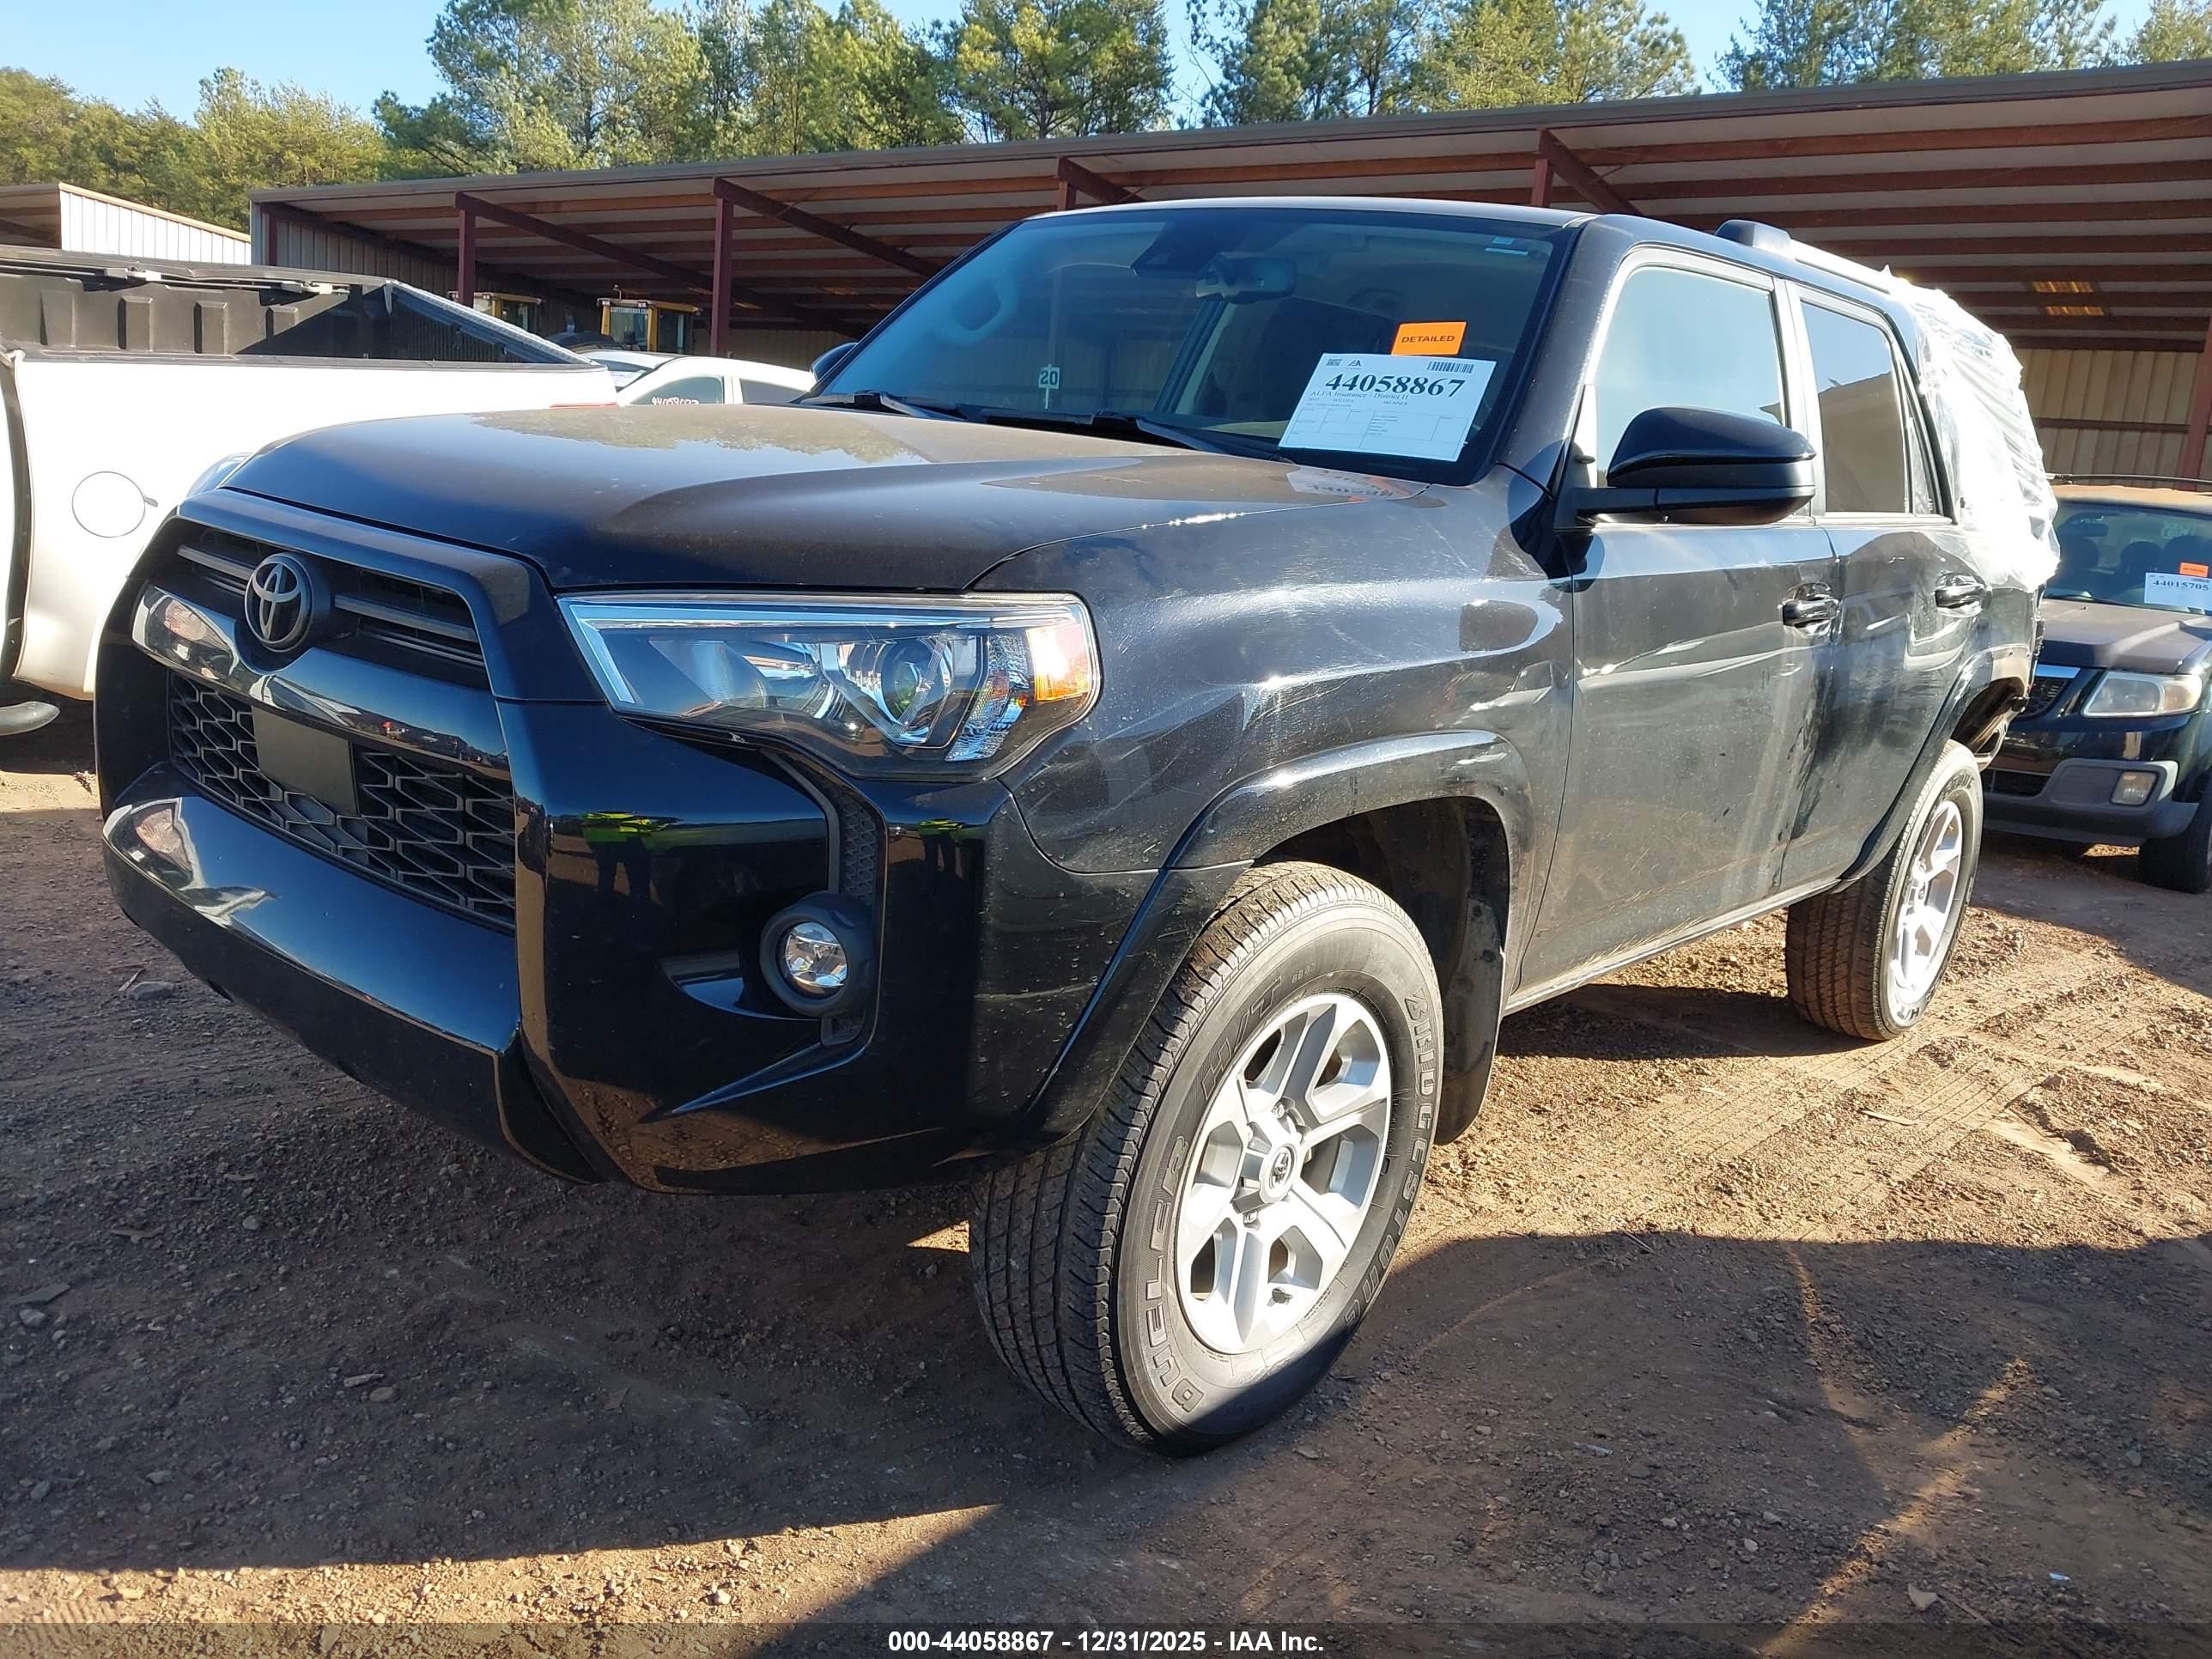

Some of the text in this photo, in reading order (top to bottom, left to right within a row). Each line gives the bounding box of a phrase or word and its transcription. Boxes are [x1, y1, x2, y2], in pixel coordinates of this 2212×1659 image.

[1401, 335, 1455, 343] DETAILED
[1040, 370, 1058, 386] 20
[1325, 374, 1467, 398] 44058867
[2153, 580, 2209, 592] 44015705
[1200, 975, 1282, 1103] H/T
[1344, 988, 1434, 1328] BRIDGESTONE
[1146, 1135, 1205, 1413] DUELER
